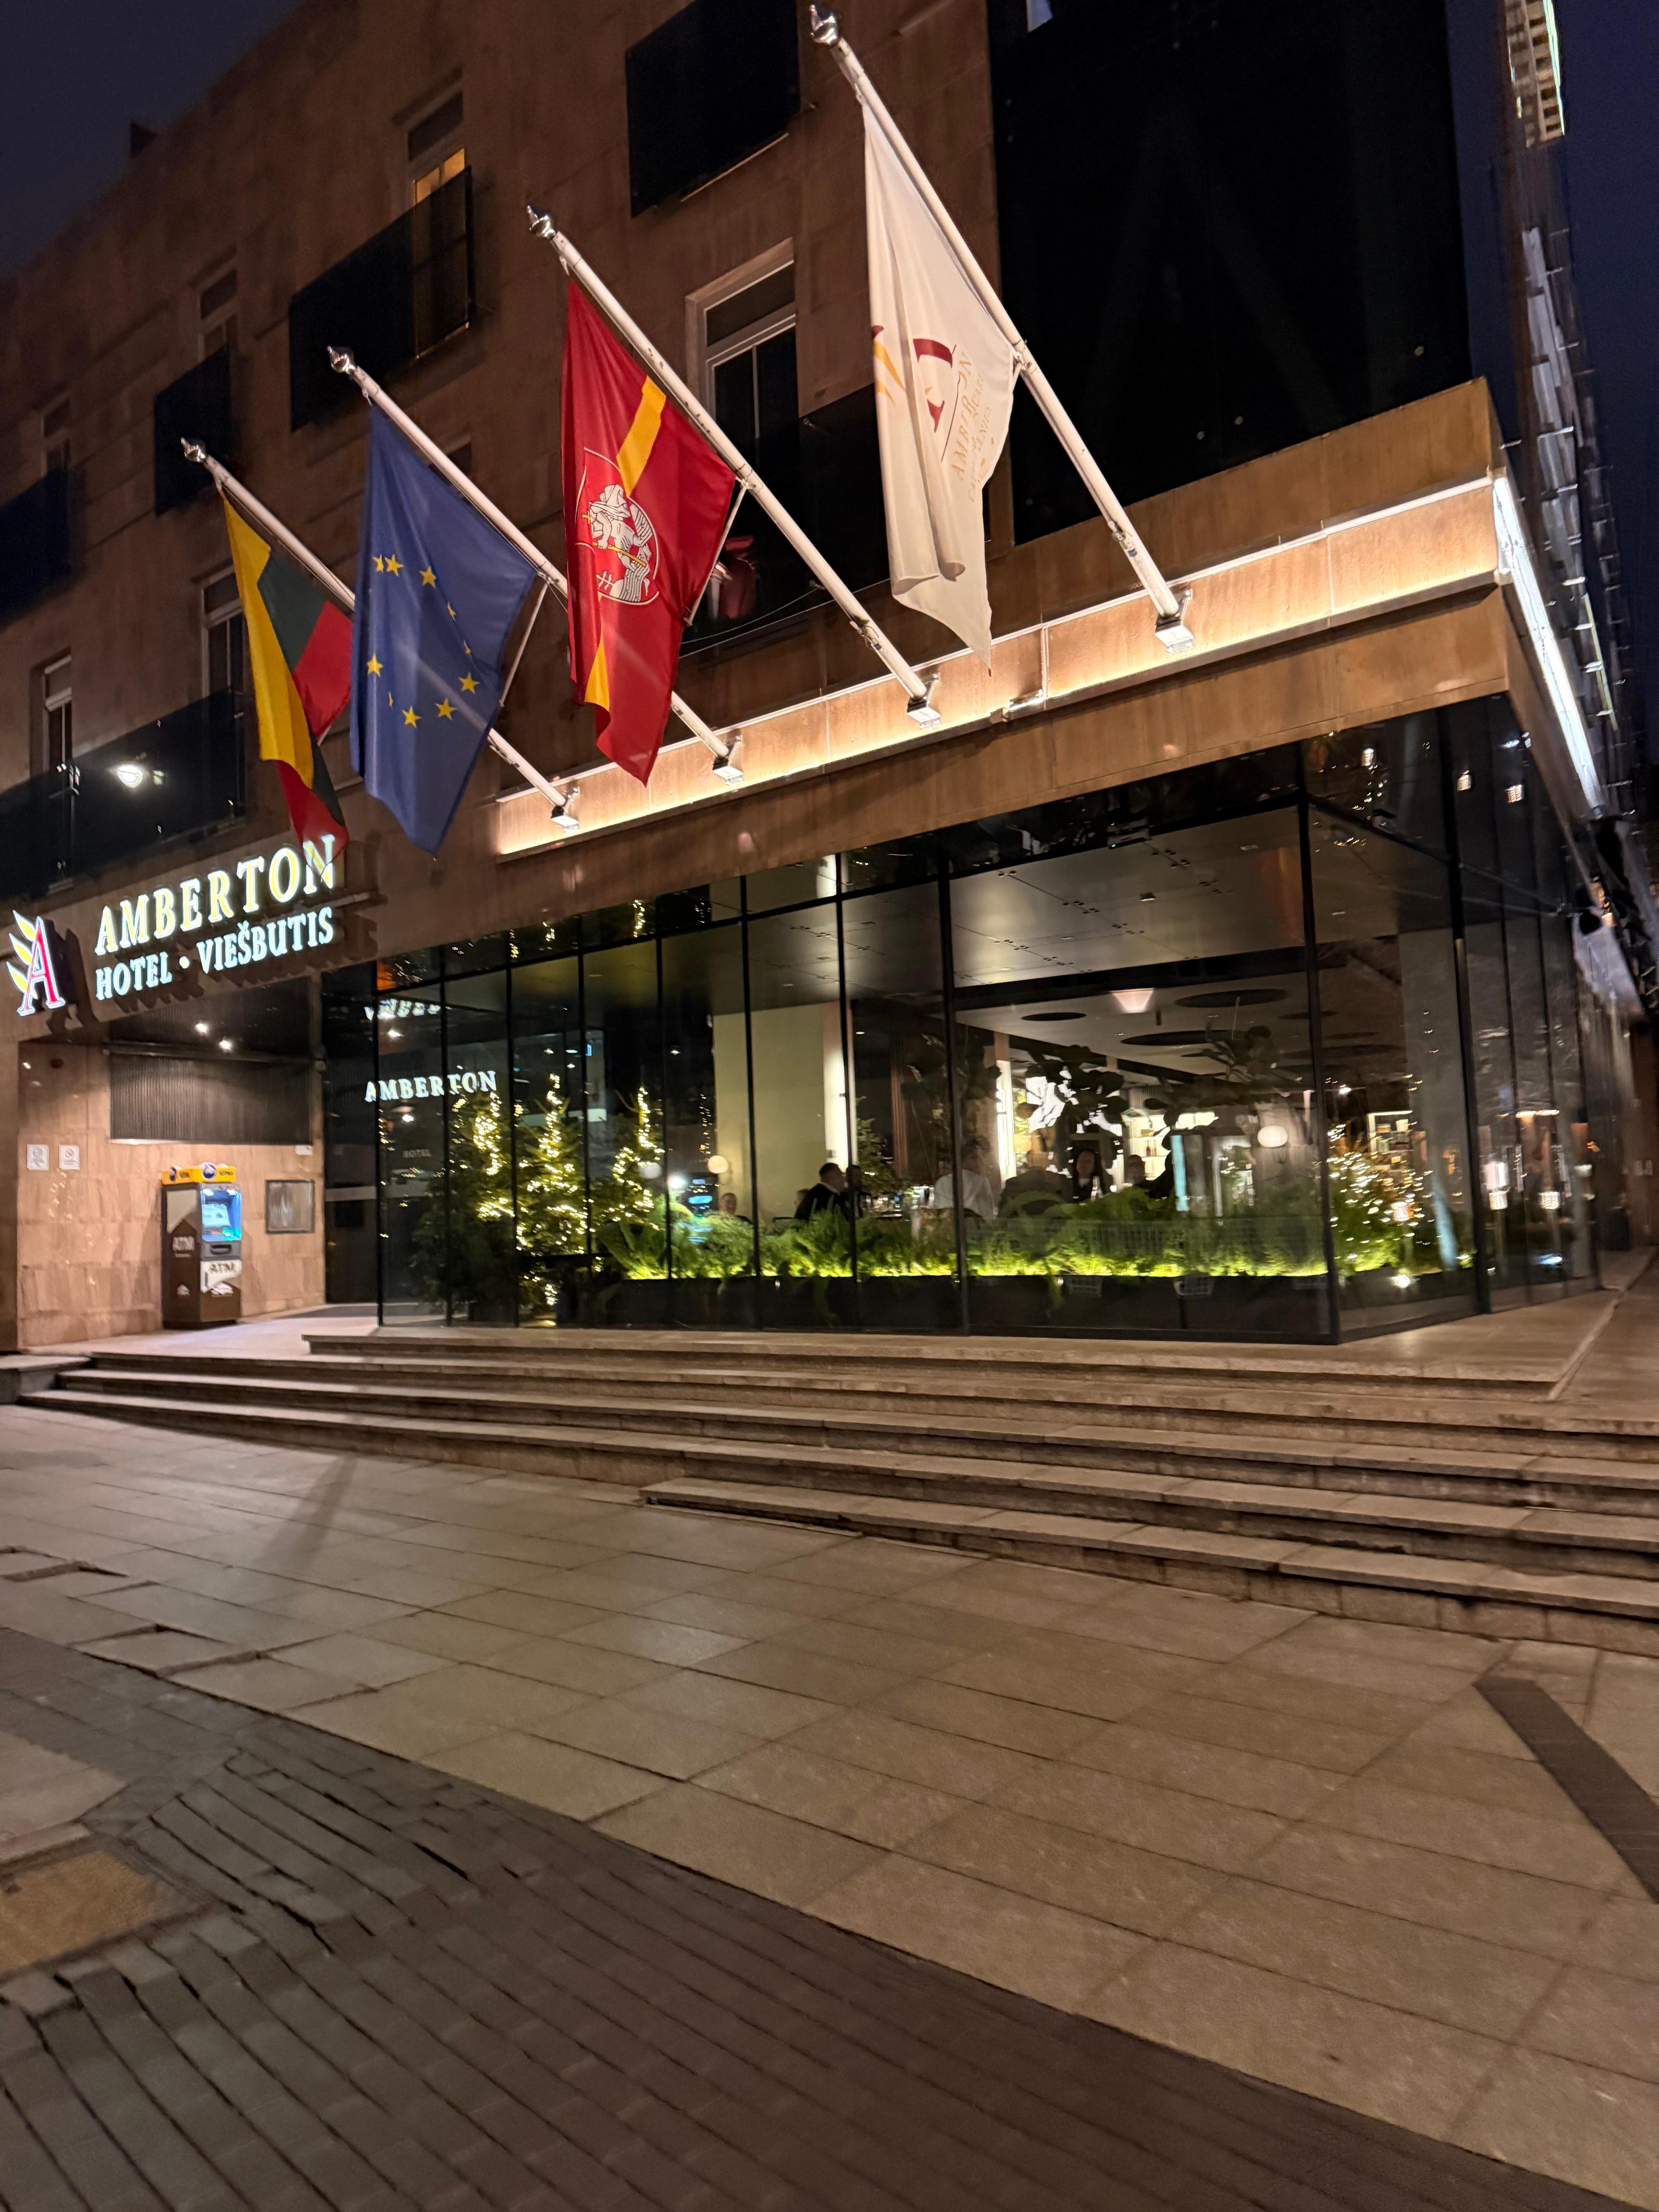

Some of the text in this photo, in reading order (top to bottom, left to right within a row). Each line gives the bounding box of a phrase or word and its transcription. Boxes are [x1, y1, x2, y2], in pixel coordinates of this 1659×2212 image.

[95, 834, 335, 956] AMBERTON
[95, 907, 333, 1000] HOTEL VIEŠBUTIS
[365, 1070, 496, 1102] AMBERTON
[210, 1262, 235, 1273] ATM
